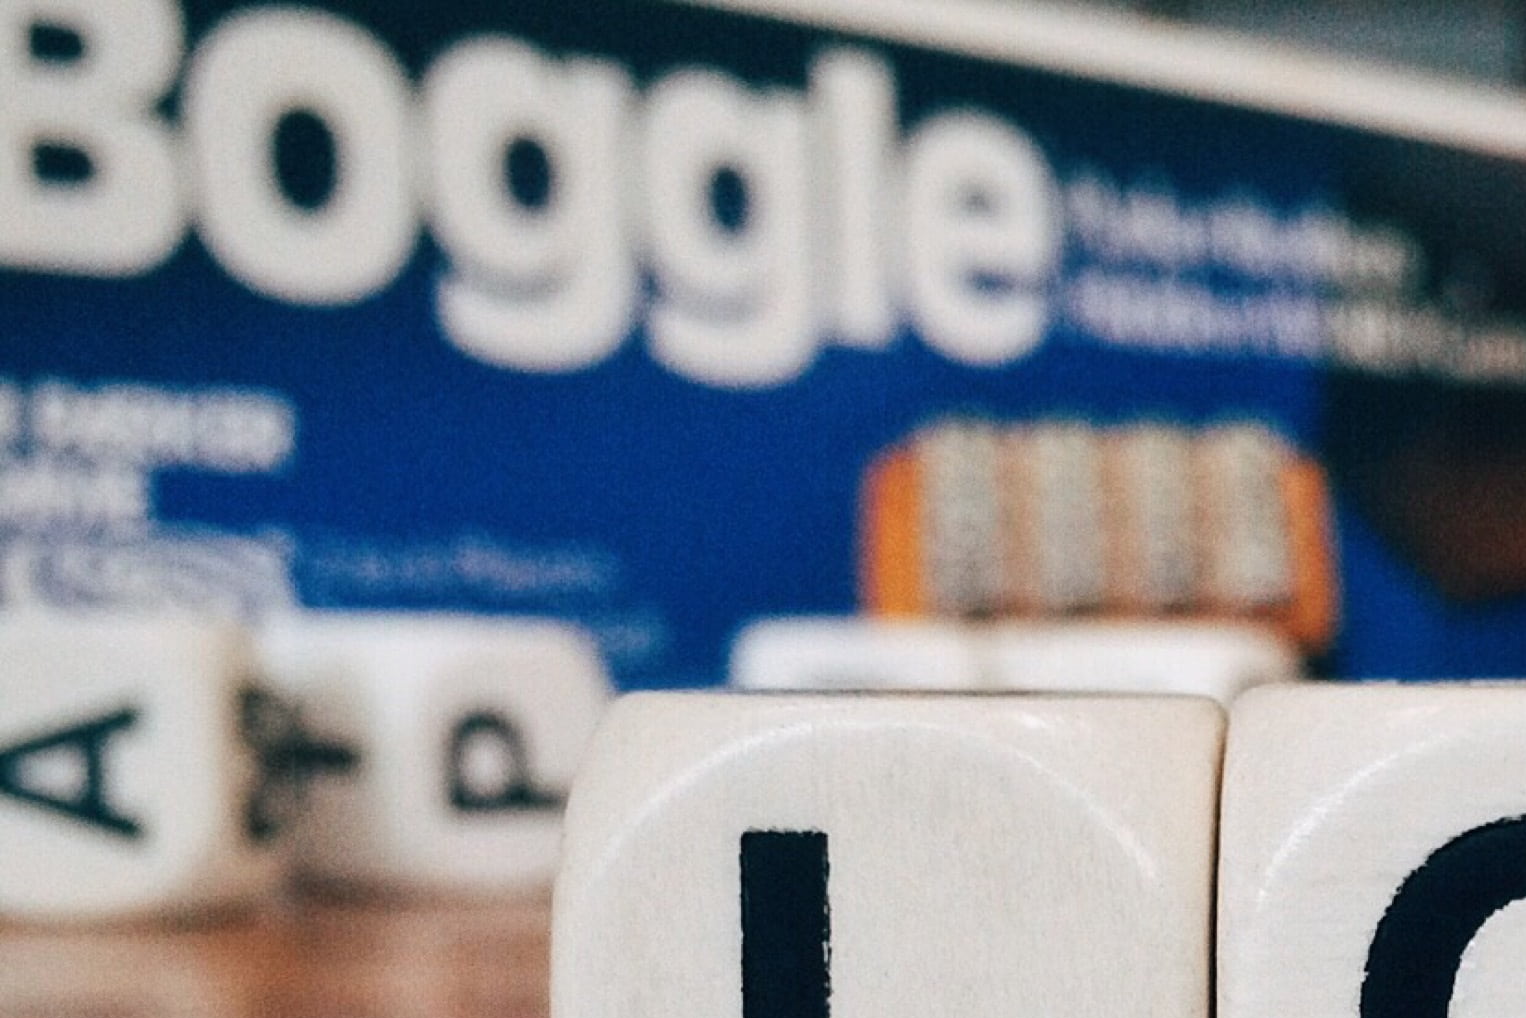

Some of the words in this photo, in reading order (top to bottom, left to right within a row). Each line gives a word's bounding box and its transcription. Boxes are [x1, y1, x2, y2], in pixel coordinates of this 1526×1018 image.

[0, 0, 1058, 388] Boggle
[0, 706, 144, 842] A
[444, 708, 567, 818] P
